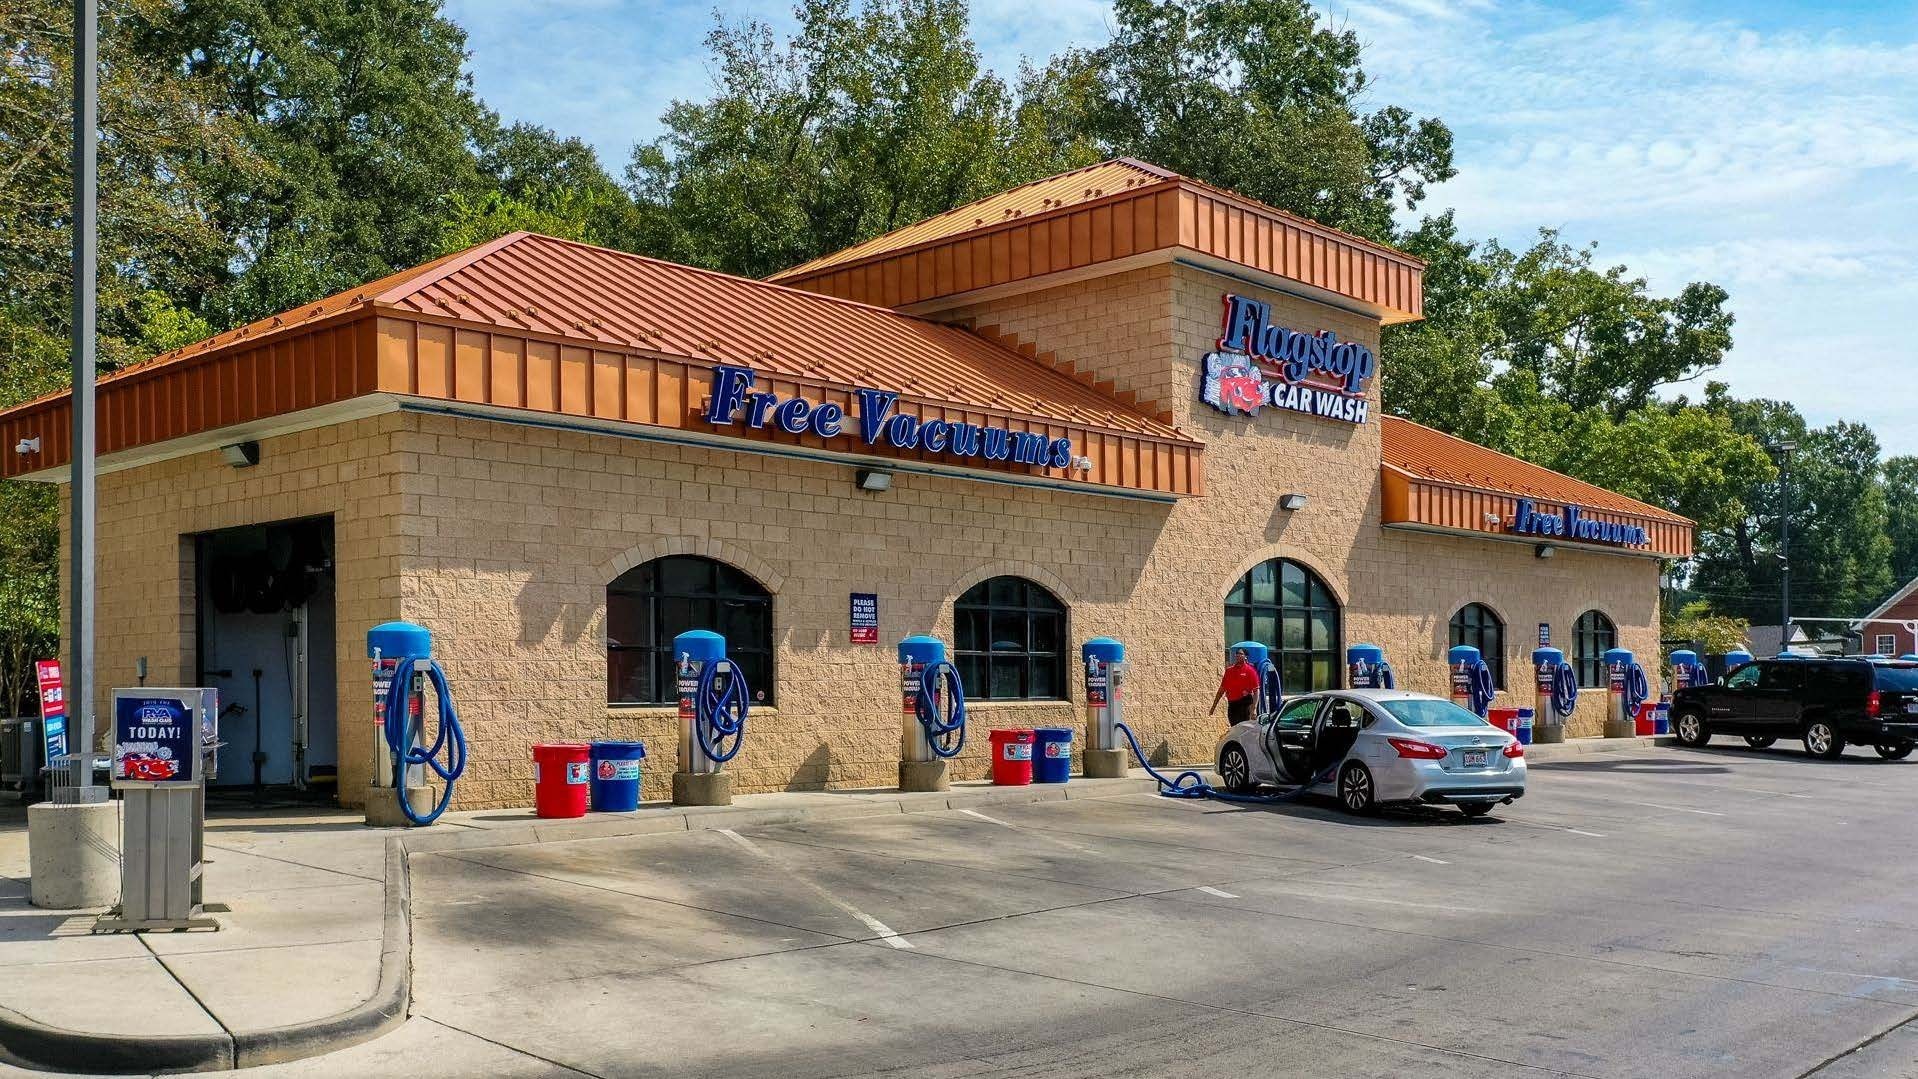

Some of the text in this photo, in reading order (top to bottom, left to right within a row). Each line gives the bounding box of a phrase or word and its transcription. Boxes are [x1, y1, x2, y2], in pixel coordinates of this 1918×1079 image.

[1218, 294, 1374, 397] Flagstop
[705, 366, 1073, 469] Free Vacuums
[1273, 383, 1369, 424] CAR WASH
[1515, 498, 1647, 546] Free Vacuums
[853, 599, 875, 607] PLEASE
[128, 726, 181, 739] TODAY!
